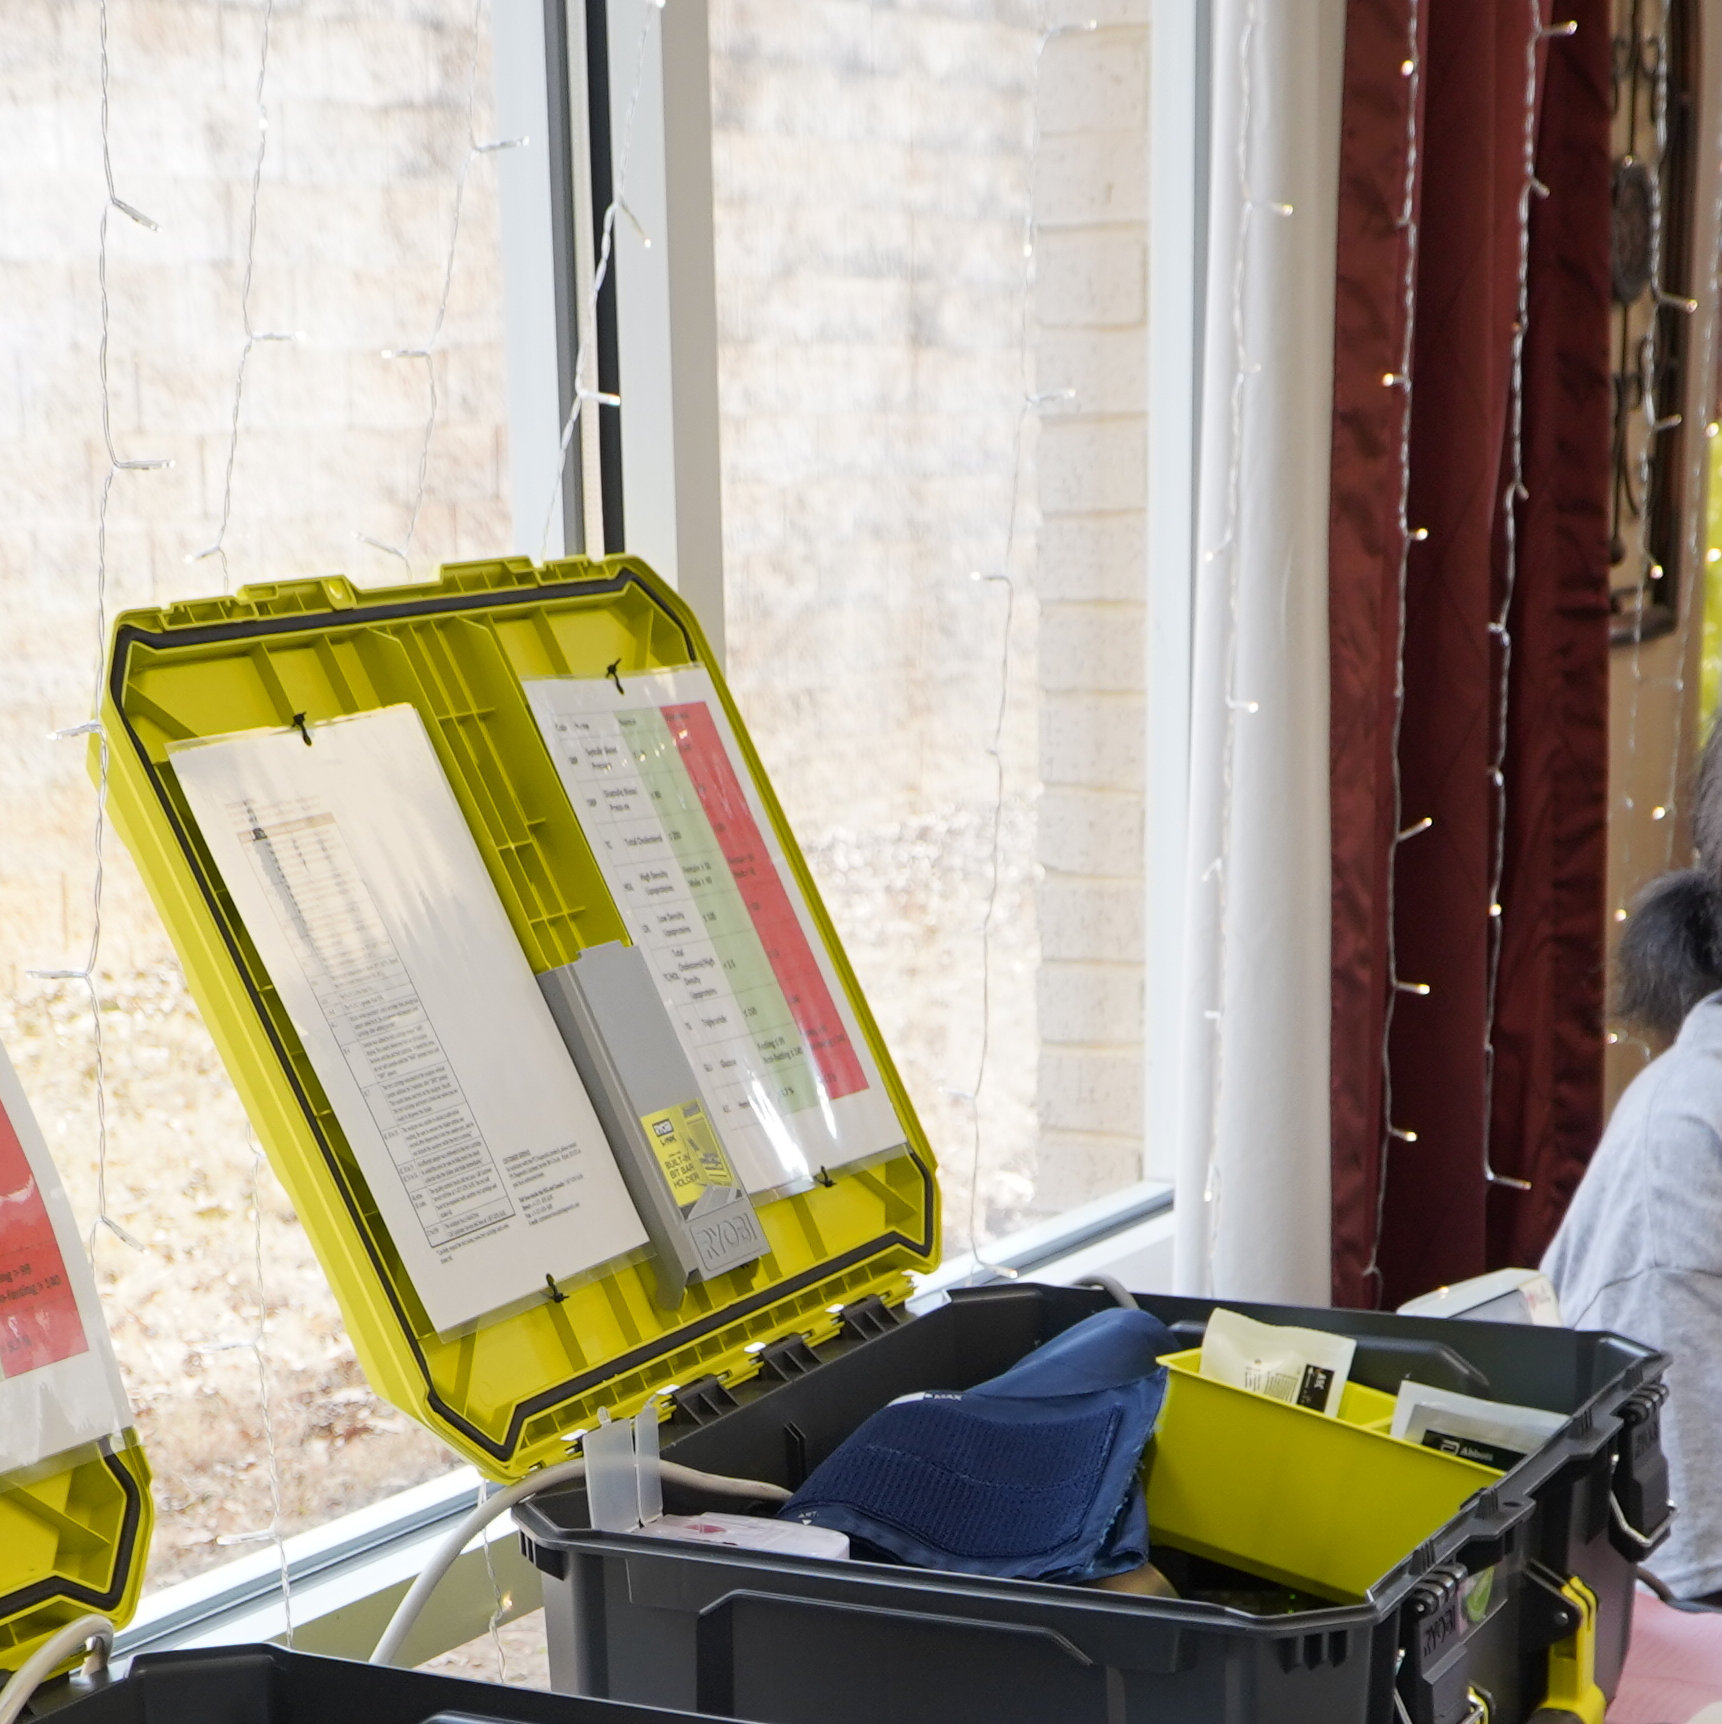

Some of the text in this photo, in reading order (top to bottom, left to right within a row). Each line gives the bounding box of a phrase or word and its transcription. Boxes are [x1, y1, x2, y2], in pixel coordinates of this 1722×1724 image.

[680, 1163, 695, 1176] BAR
[673, 1172, 701, 1188] HOLDER
[696, 1212, 758, 1260] RYOBI
[1460, 1447, 1493, 1462] Abbott
